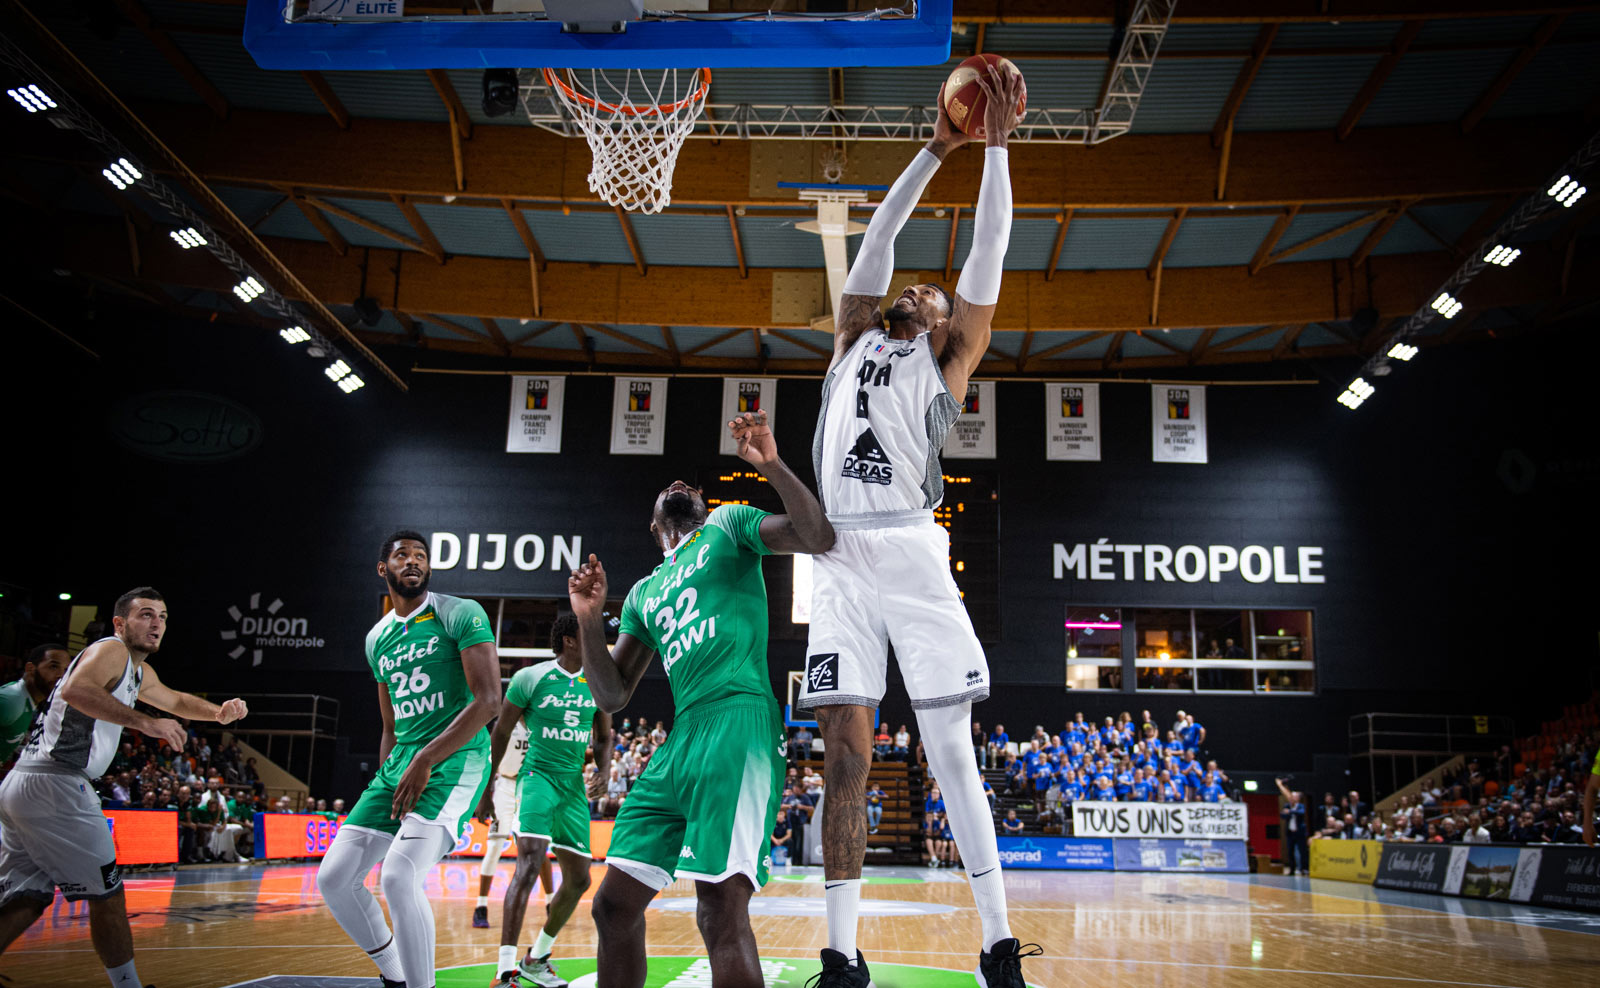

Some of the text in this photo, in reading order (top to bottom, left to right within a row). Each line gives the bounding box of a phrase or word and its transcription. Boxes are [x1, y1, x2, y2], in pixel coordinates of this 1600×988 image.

[356, 1, 397, 14] ÉLITE
[528, 381, 548, 390] JDA
[630, 383, 651, 392] JDA
[740, 383, 760, 392] JDA
[1062, 388, 1082, 397] JDA
[1168, 390, 1188, 399] JDA
[430, 532, 582, 571] DIJON
[1053, 538, 1326, 584] MÉTROPOLE
[655, 587, 700, 644] 32
[256, 636, 325, 648] métropole
[378, 636, 440, 676] Portel
[390, 665, 430, 698] 26
[563, 709, 580, 727] 5
[1077, 807, 1184, 834] TOUS UNIS
[998, 850, 1042, 864] egerad
